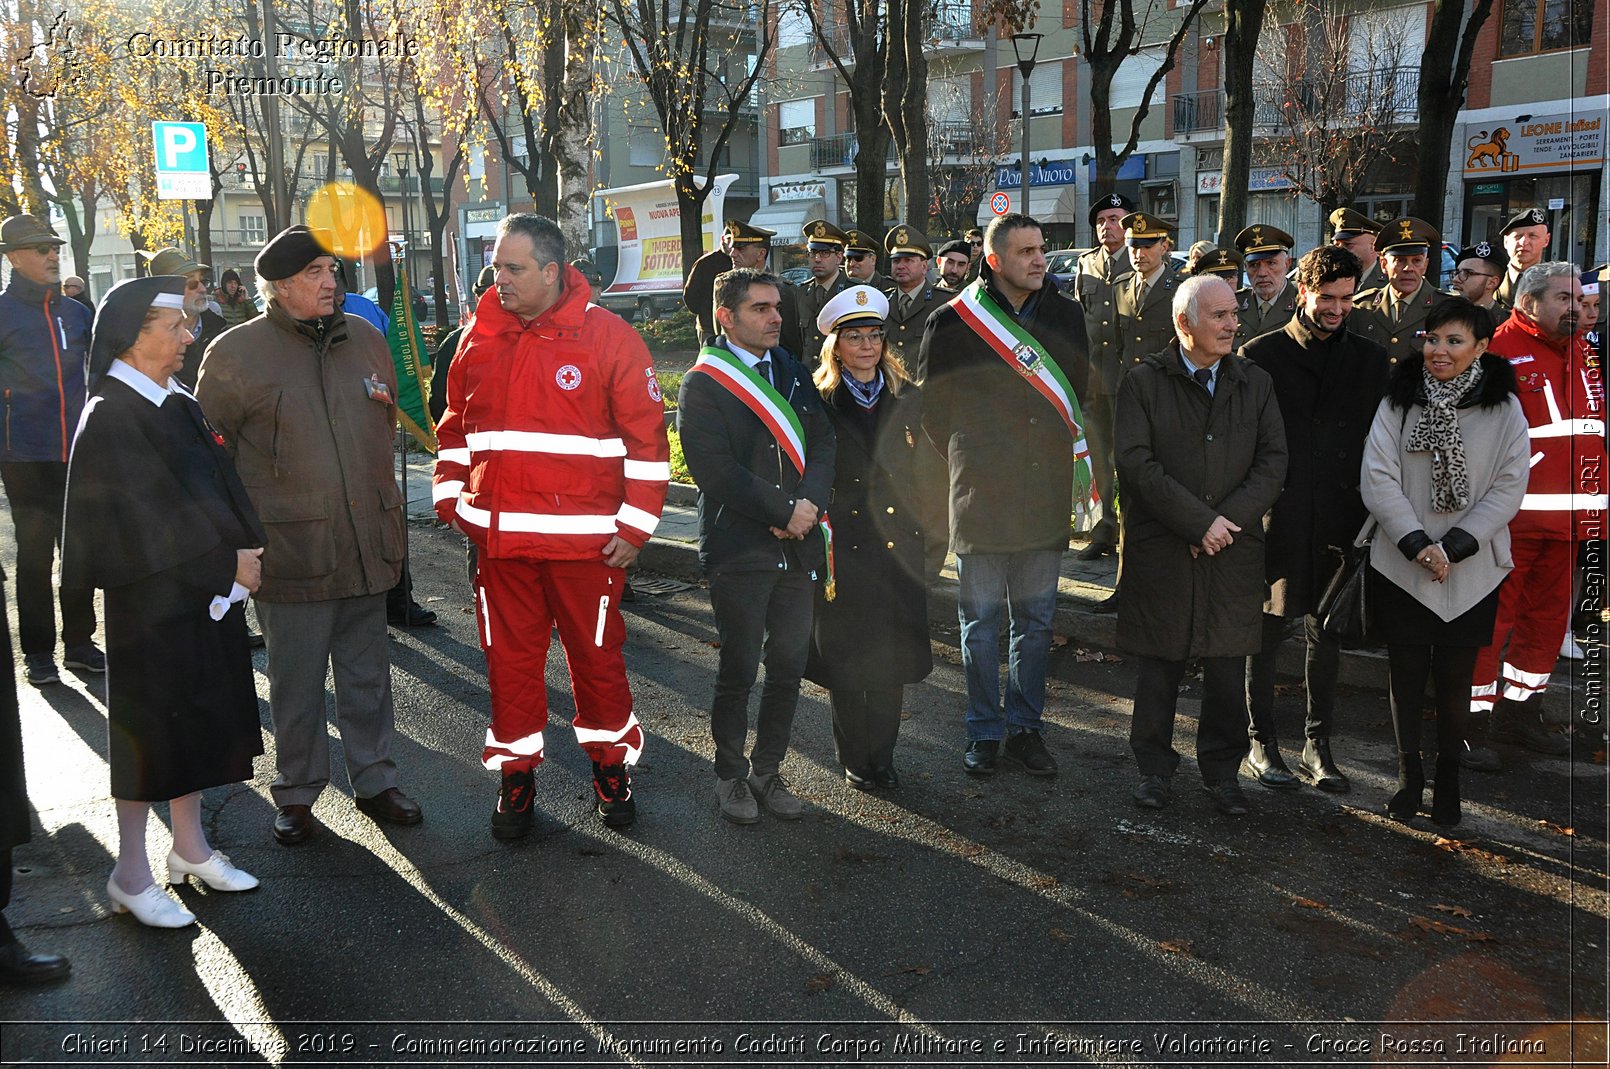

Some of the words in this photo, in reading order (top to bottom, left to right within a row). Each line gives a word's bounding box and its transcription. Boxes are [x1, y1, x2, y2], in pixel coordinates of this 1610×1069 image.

[1520, 121, 1562, 138] LEONE
[1535, 136, 1573, 145] SERRAMENT
[1579, 133, 1600, 141] PORTE
[163, 126, 196, 168] P
[1533, 145, 1552, 153] TENDE
[1556, 142, 1599, 152] AVVOLGIBILI
[1559, 150, 1598, 159] ZANZARIERE
[998, 167, 1034, 186] Pone
[1036, 166, 1073, 183] Nuovo
[648, 210, 670, 220] NUOVA
[652, 240, 682, 253] IMPERD
[393, 290, 406, 328] SEZIONE
[399, 331, 408, 341] DI
[400, 343, 415, 376] TORINO
